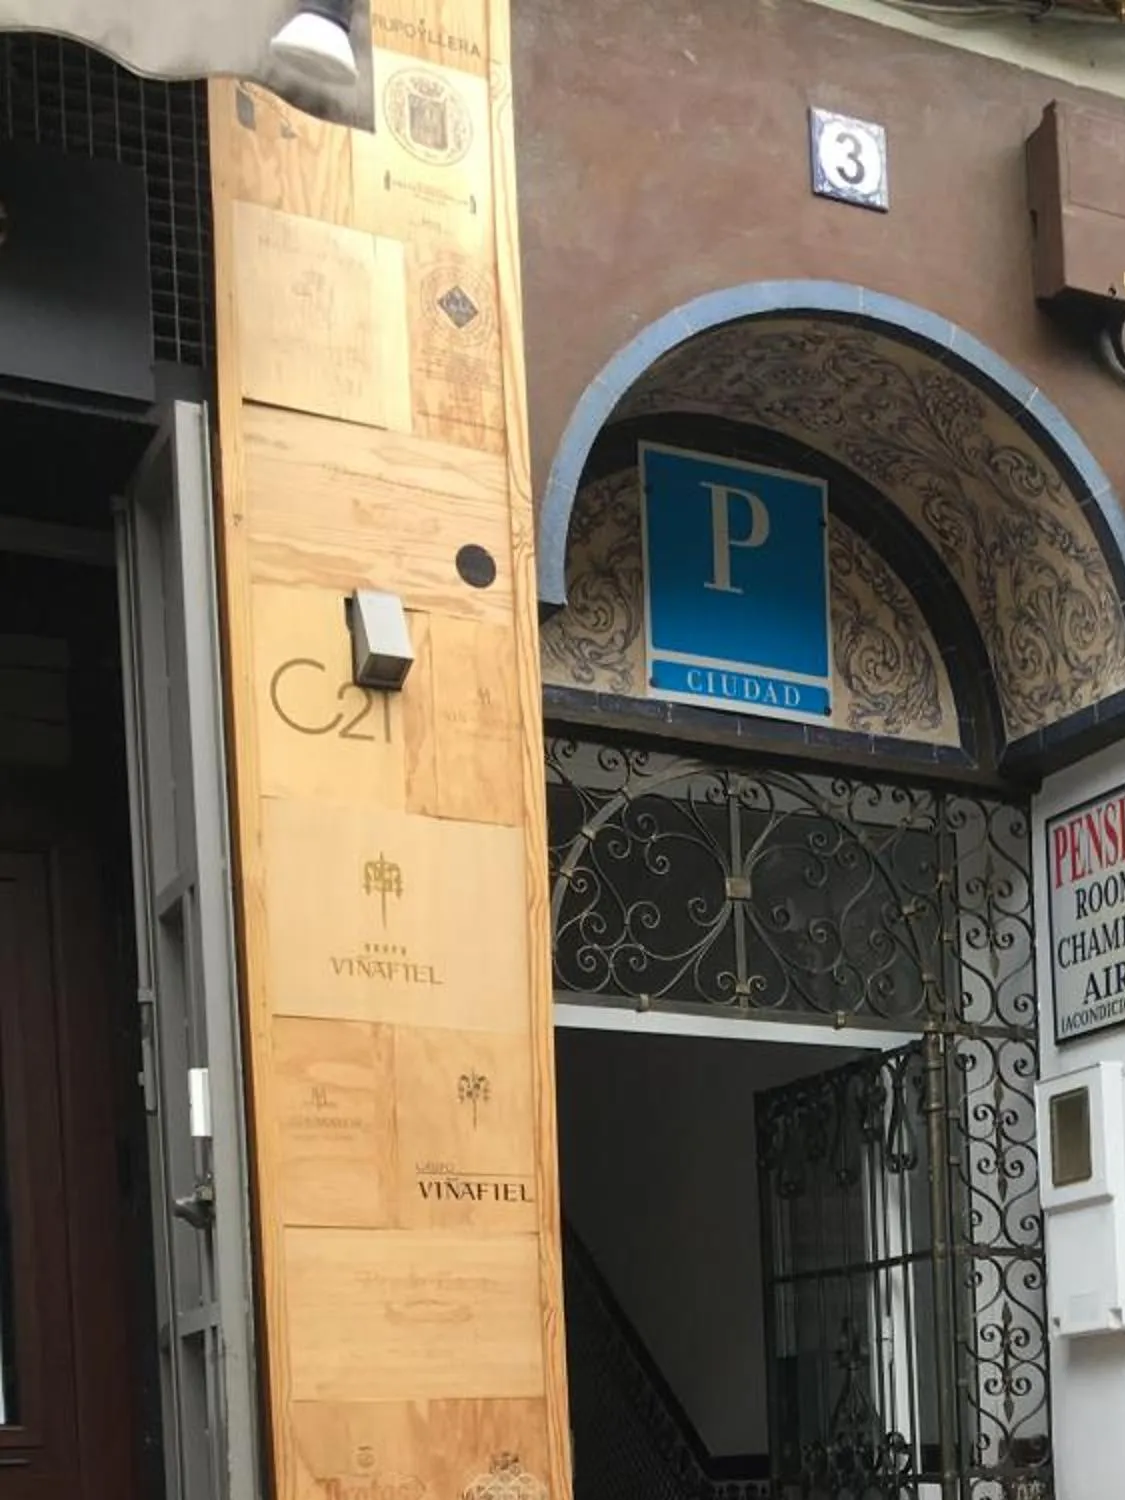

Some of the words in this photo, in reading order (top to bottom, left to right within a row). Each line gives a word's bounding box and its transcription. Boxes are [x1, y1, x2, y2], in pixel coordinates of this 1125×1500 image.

[836, 132, 865, 185] 3
[699, 481, 770, 594] P
[686, 668, 801, 707] CIUDAD
[418, 1177, 535, 1203] VIÑAFIEL
